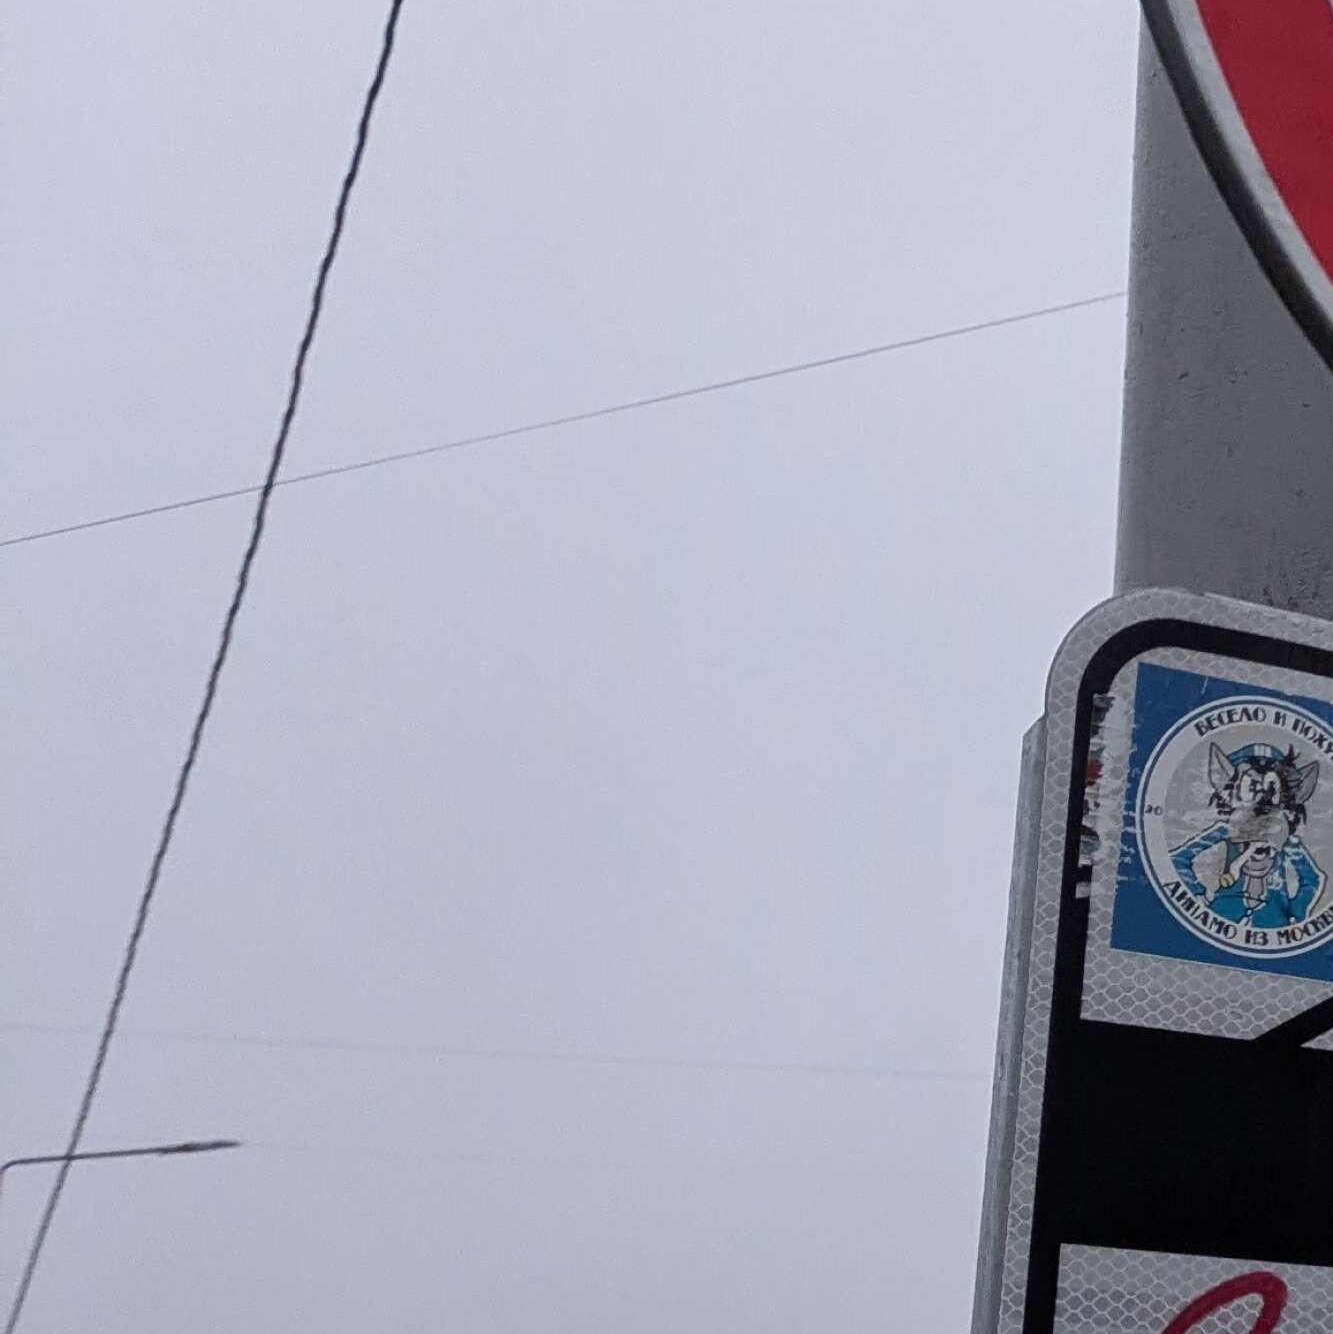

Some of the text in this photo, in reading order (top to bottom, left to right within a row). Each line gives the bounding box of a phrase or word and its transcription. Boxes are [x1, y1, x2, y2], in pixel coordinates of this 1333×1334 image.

[1194, 706, 1267, 737] ВЕСЕЛО
[1273, 710, 1287, 727] И
[1163, 880, 1238, 940] ДИНАМО
[1244, 929, 1269, 946] ИЗ
